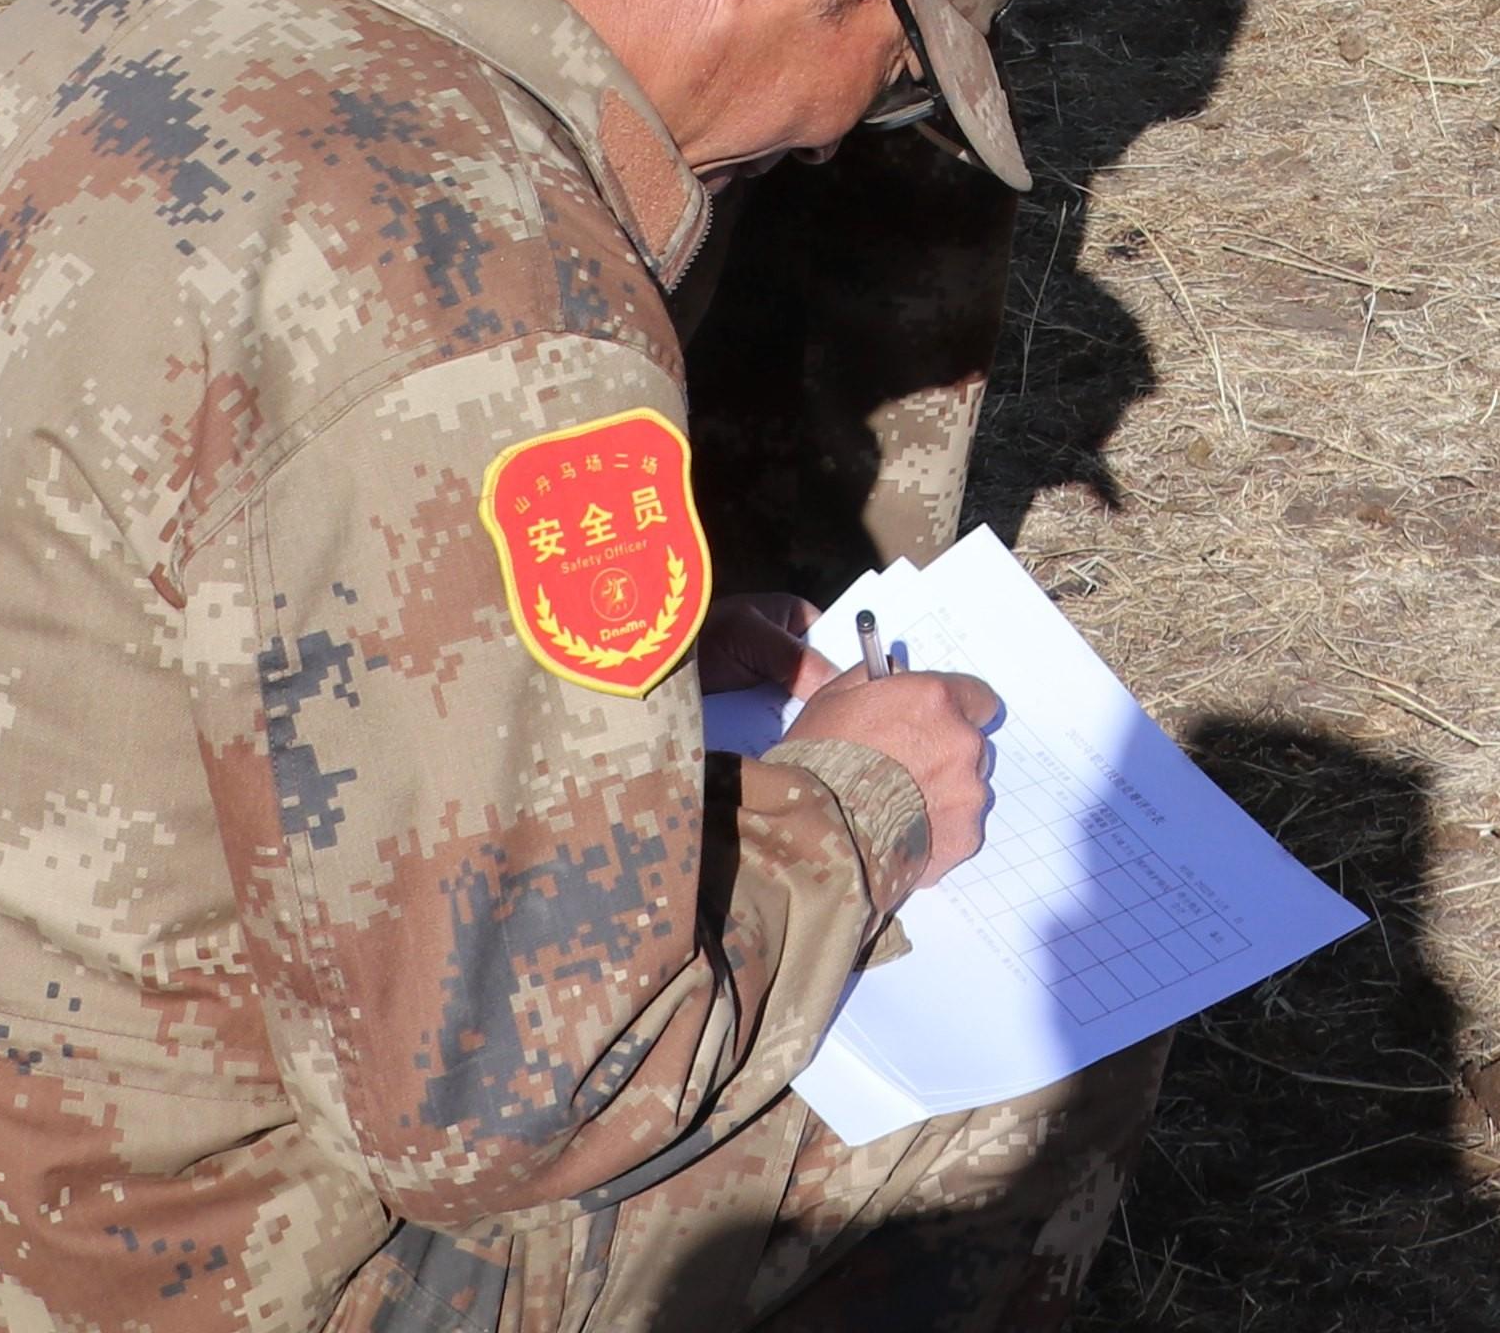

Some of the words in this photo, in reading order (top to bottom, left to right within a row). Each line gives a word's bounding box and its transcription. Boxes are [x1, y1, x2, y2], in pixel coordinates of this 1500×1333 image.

[514, 453, 658, 514] 山丹马场二场
[527, 486, 668, 564] 安全员
[560, 555, 602, 575] Safety
[604, 538, 648, 560] Officer
